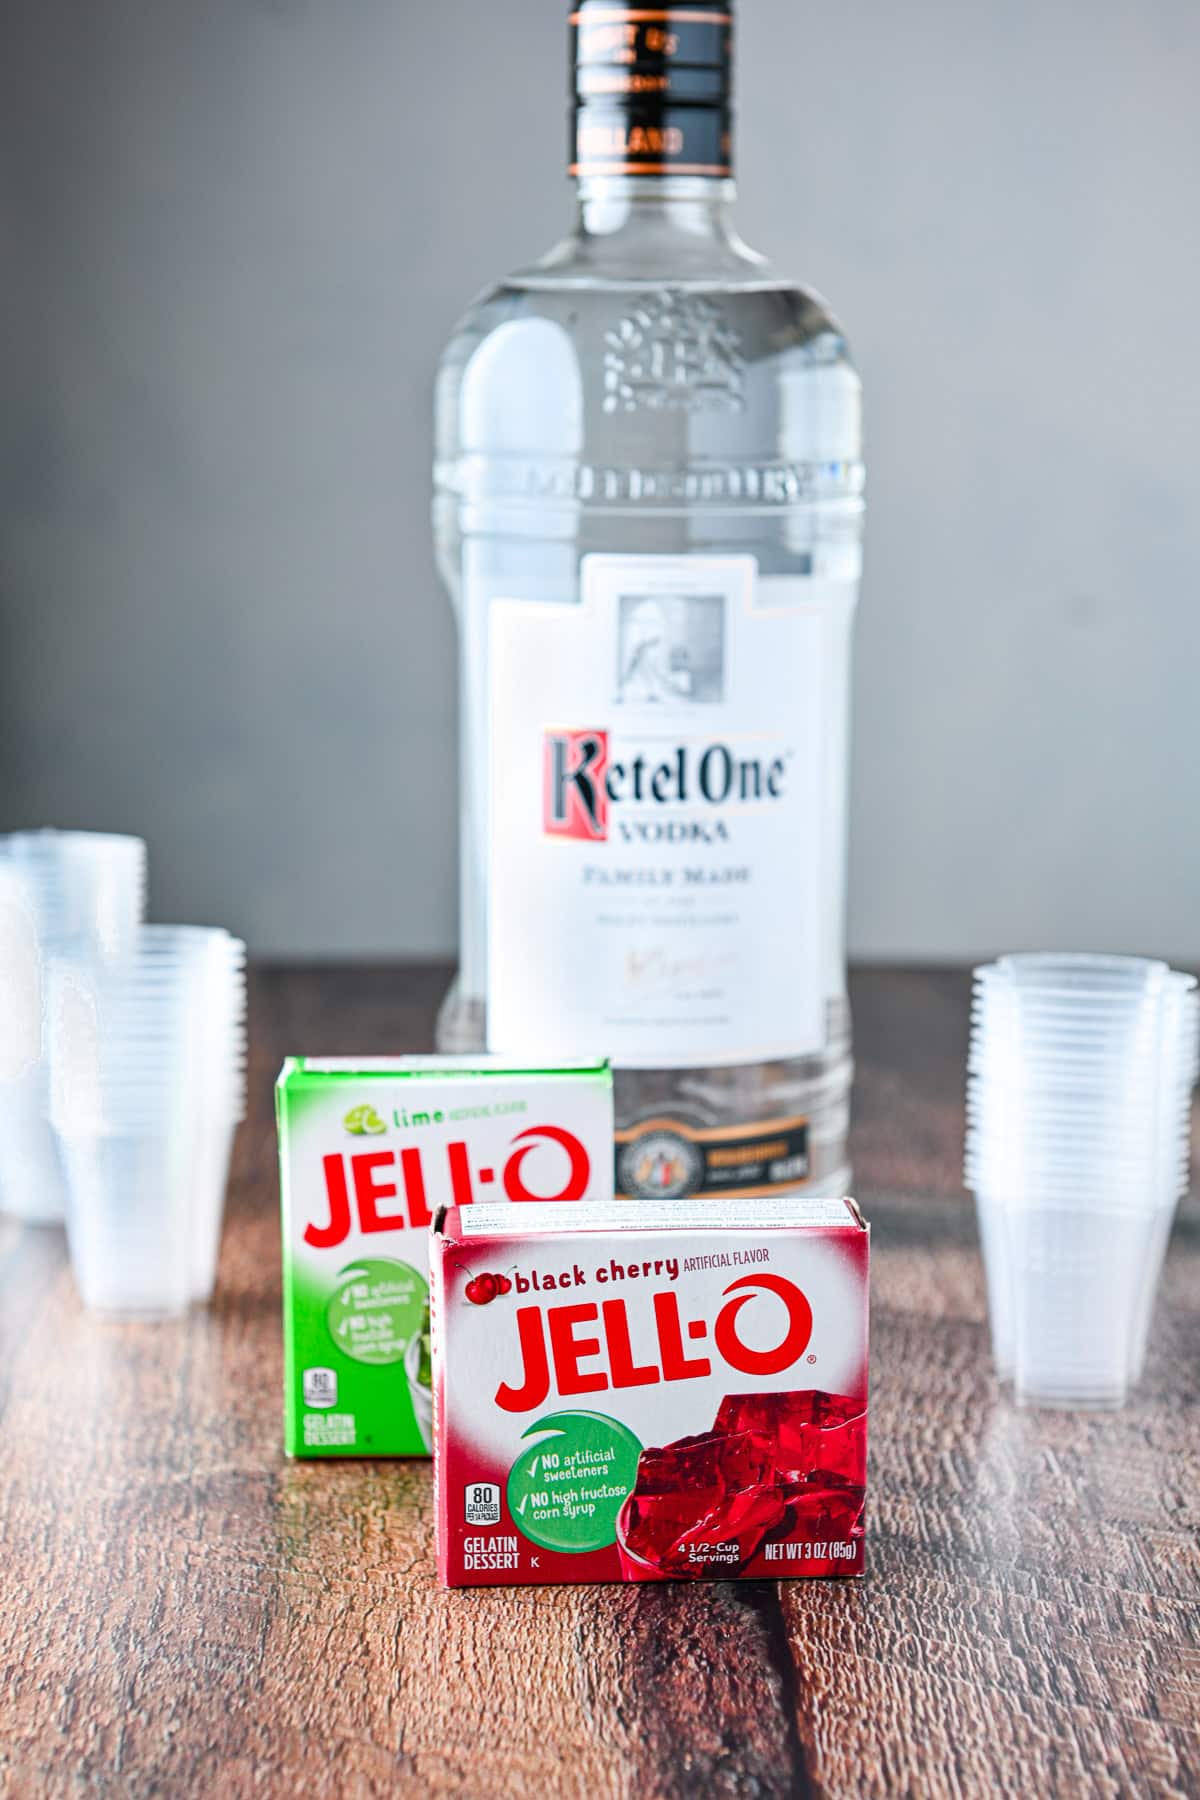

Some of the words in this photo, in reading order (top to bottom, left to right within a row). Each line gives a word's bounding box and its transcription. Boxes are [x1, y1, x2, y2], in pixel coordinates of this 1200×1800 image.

[552, 738, 687, 832] Ketel
[699, 743, 786, 804] One
[619, 820, 730, 843] VODKA
[393, 1108, 444, 1129] lime
[515, 1264, 586, 1294] black
[596, 1259, 680, 1281] cherry
[683, 1255, 732, 1273] ARTIFICIAL
[733, 1248, 770, 1266] FLAVOR
[494, 1273, 813, 1413] JELL-O
[541, 1454, 560, 1470] NO
[563, 1447, 616, 1466] artificial
[543, 1464, 609, 1482] sweeteners
[473, 1487, 493, 1504] 80
[530, 1492, 549, 1508] NO
[551, 1487, 579, 1507] high
[580, 1484, 627, 1501] fructose
[467, 1503, 498, 1513] CALORIES
[532, 1507, 560, 1520] corn
[562, 1502, 596, 1519] syrup
[463, 1536, 518, 1553] GELATIN
[677, 1543, 686, 1553] 4
[688, 1542, 740, 1553] 1/2-Cup
[764, 1543, 784, 1560] NET
[786, 1543, 803, 1560] WT
[804, 1543, 812, 1559] 3
[814, 1542, 827, 1558] OZ
[828, 1541, 857, 1561] (85g)
[463, 1552, 520, 1570] DESSERT
[530, 1556, 540, 1568] K
[688, 1552, 740, 1563] Servings
